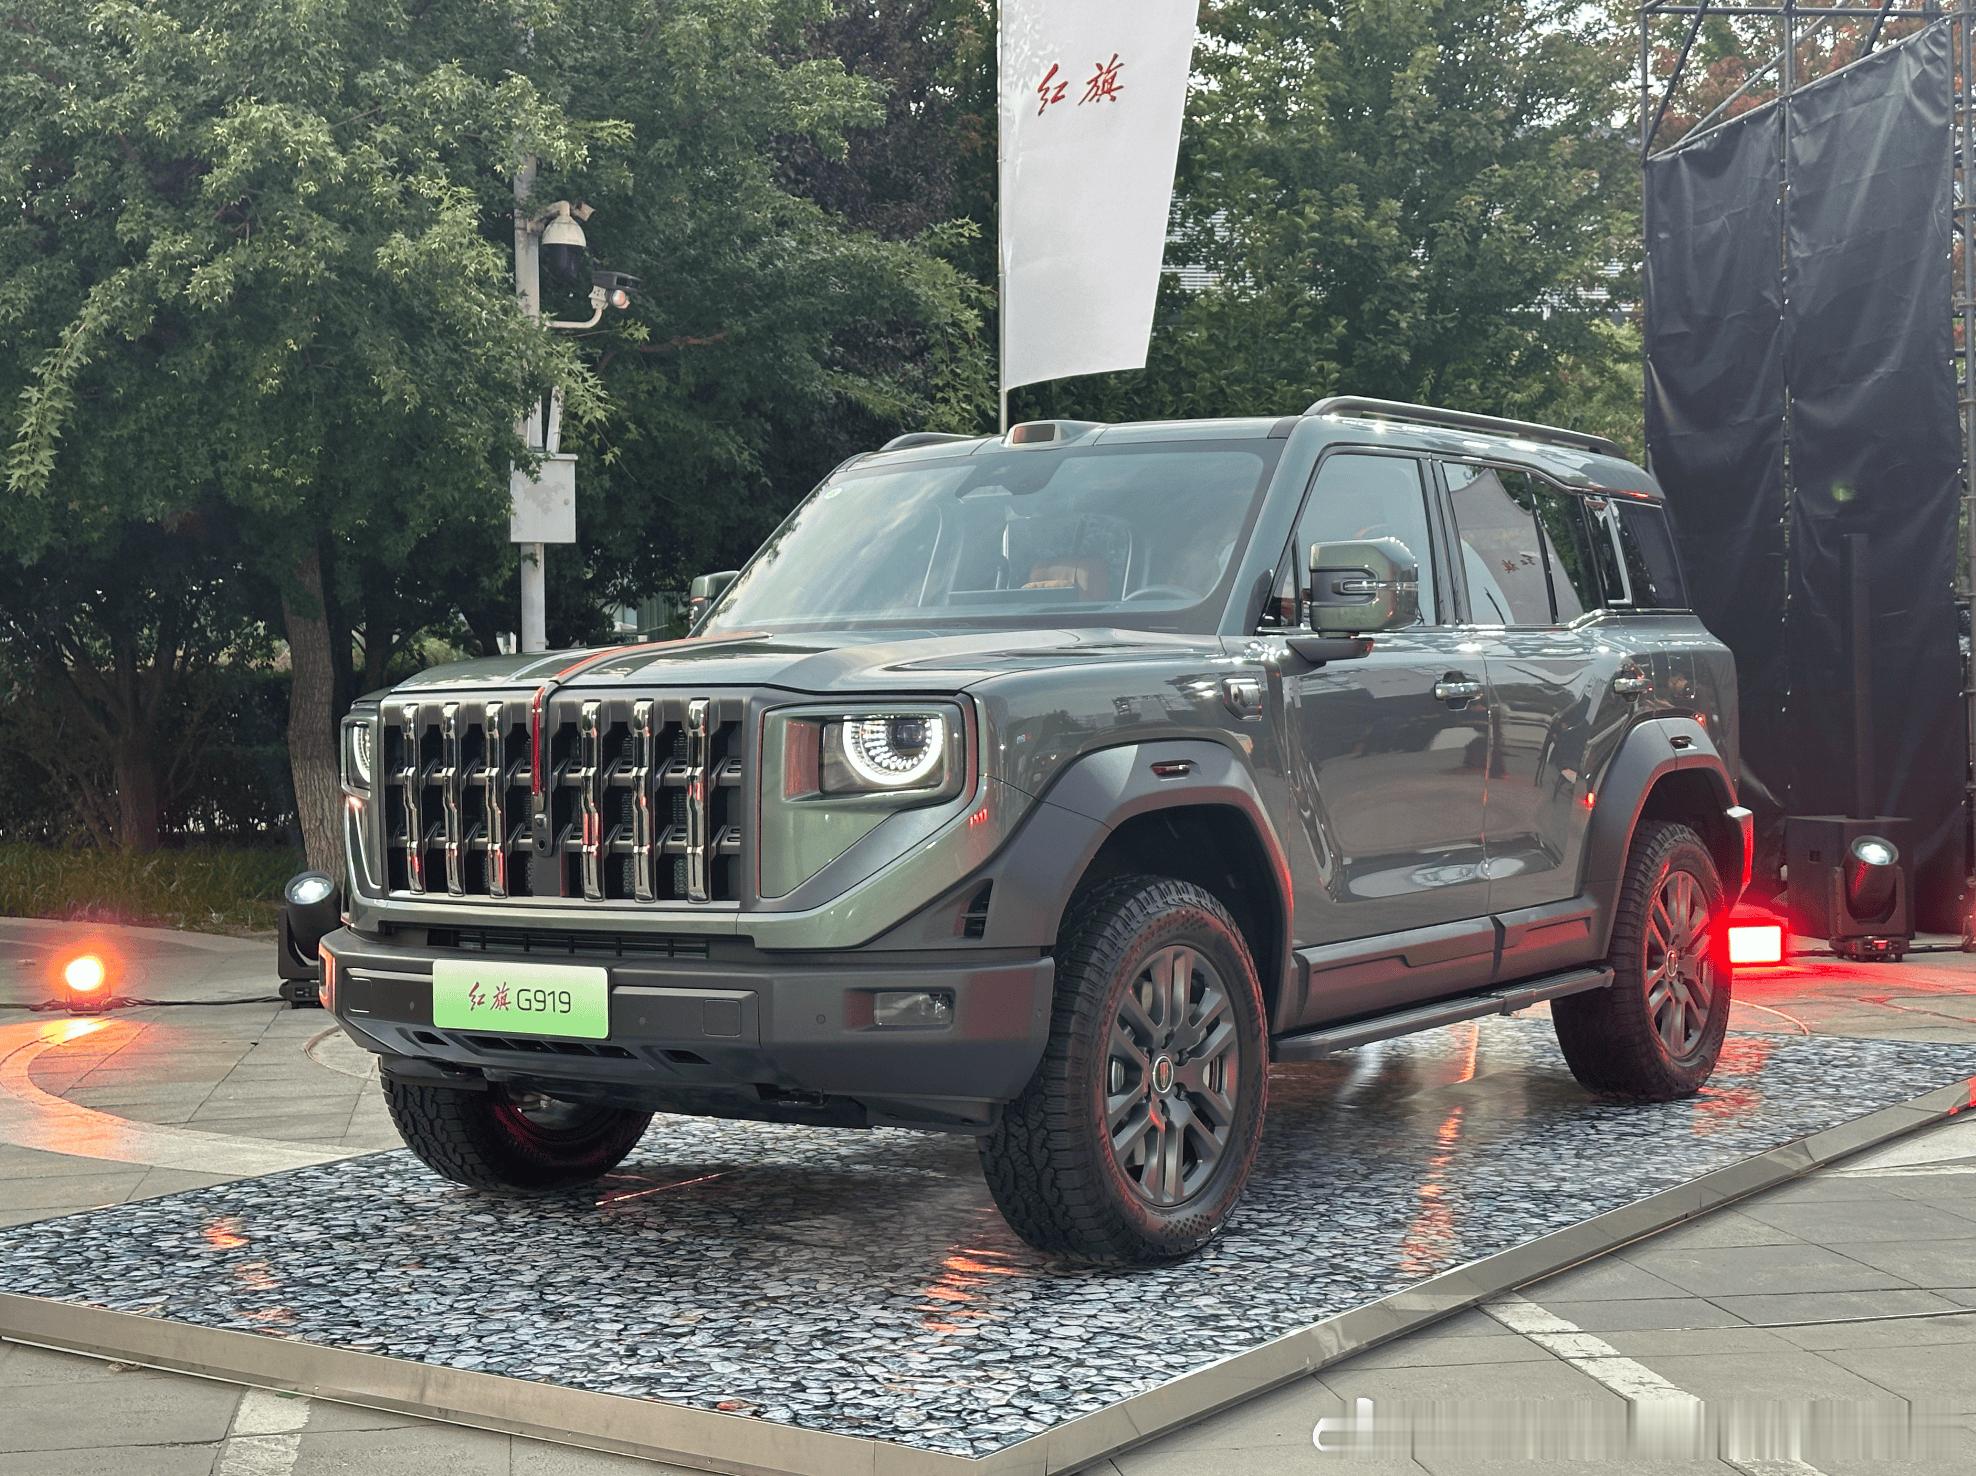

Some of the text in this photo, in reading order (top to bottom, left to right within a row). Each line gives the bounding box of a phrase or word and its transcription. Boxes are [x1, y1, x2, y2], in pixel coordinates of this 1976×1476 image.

[1037, 53, 1124, 116] 红旗
[468, 981, 571, 1014] 红旗 G919
